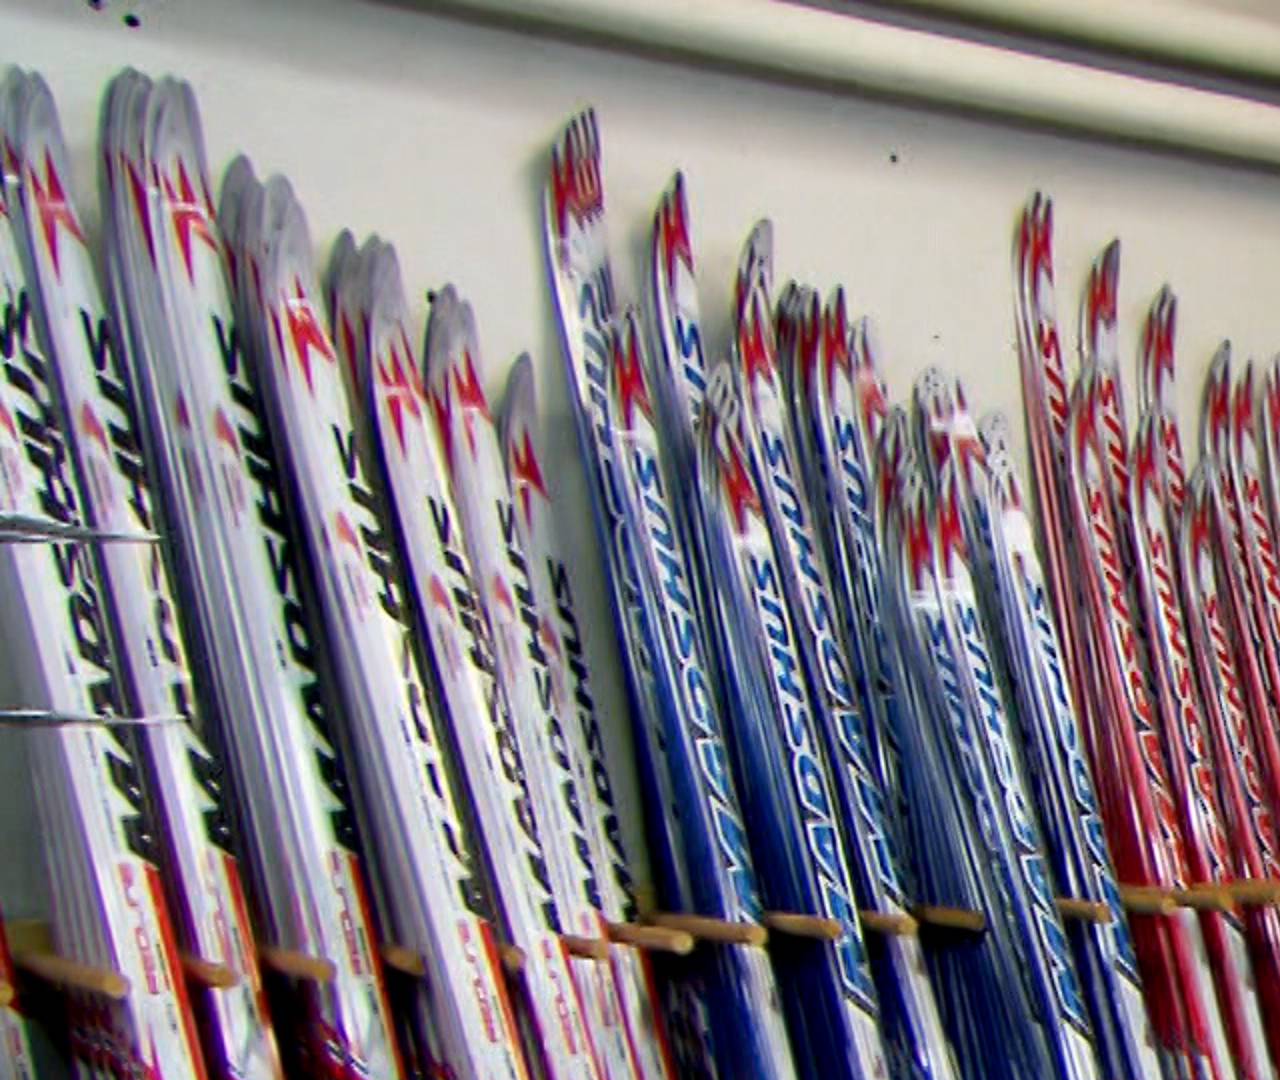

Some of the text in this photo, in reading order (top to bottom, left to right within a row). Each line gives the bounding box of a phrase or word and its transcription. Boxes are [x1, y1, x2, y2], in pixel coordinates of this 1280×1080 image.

[211, 313, 359, 852] MADSHUS
[545, 554, 639, 920] MADSHUS
[629, 446, 767, 927] MADSHUS
[747, 555, 877, 1002] MADSHUS
[759, 429, 912, 912] MADSHUS
